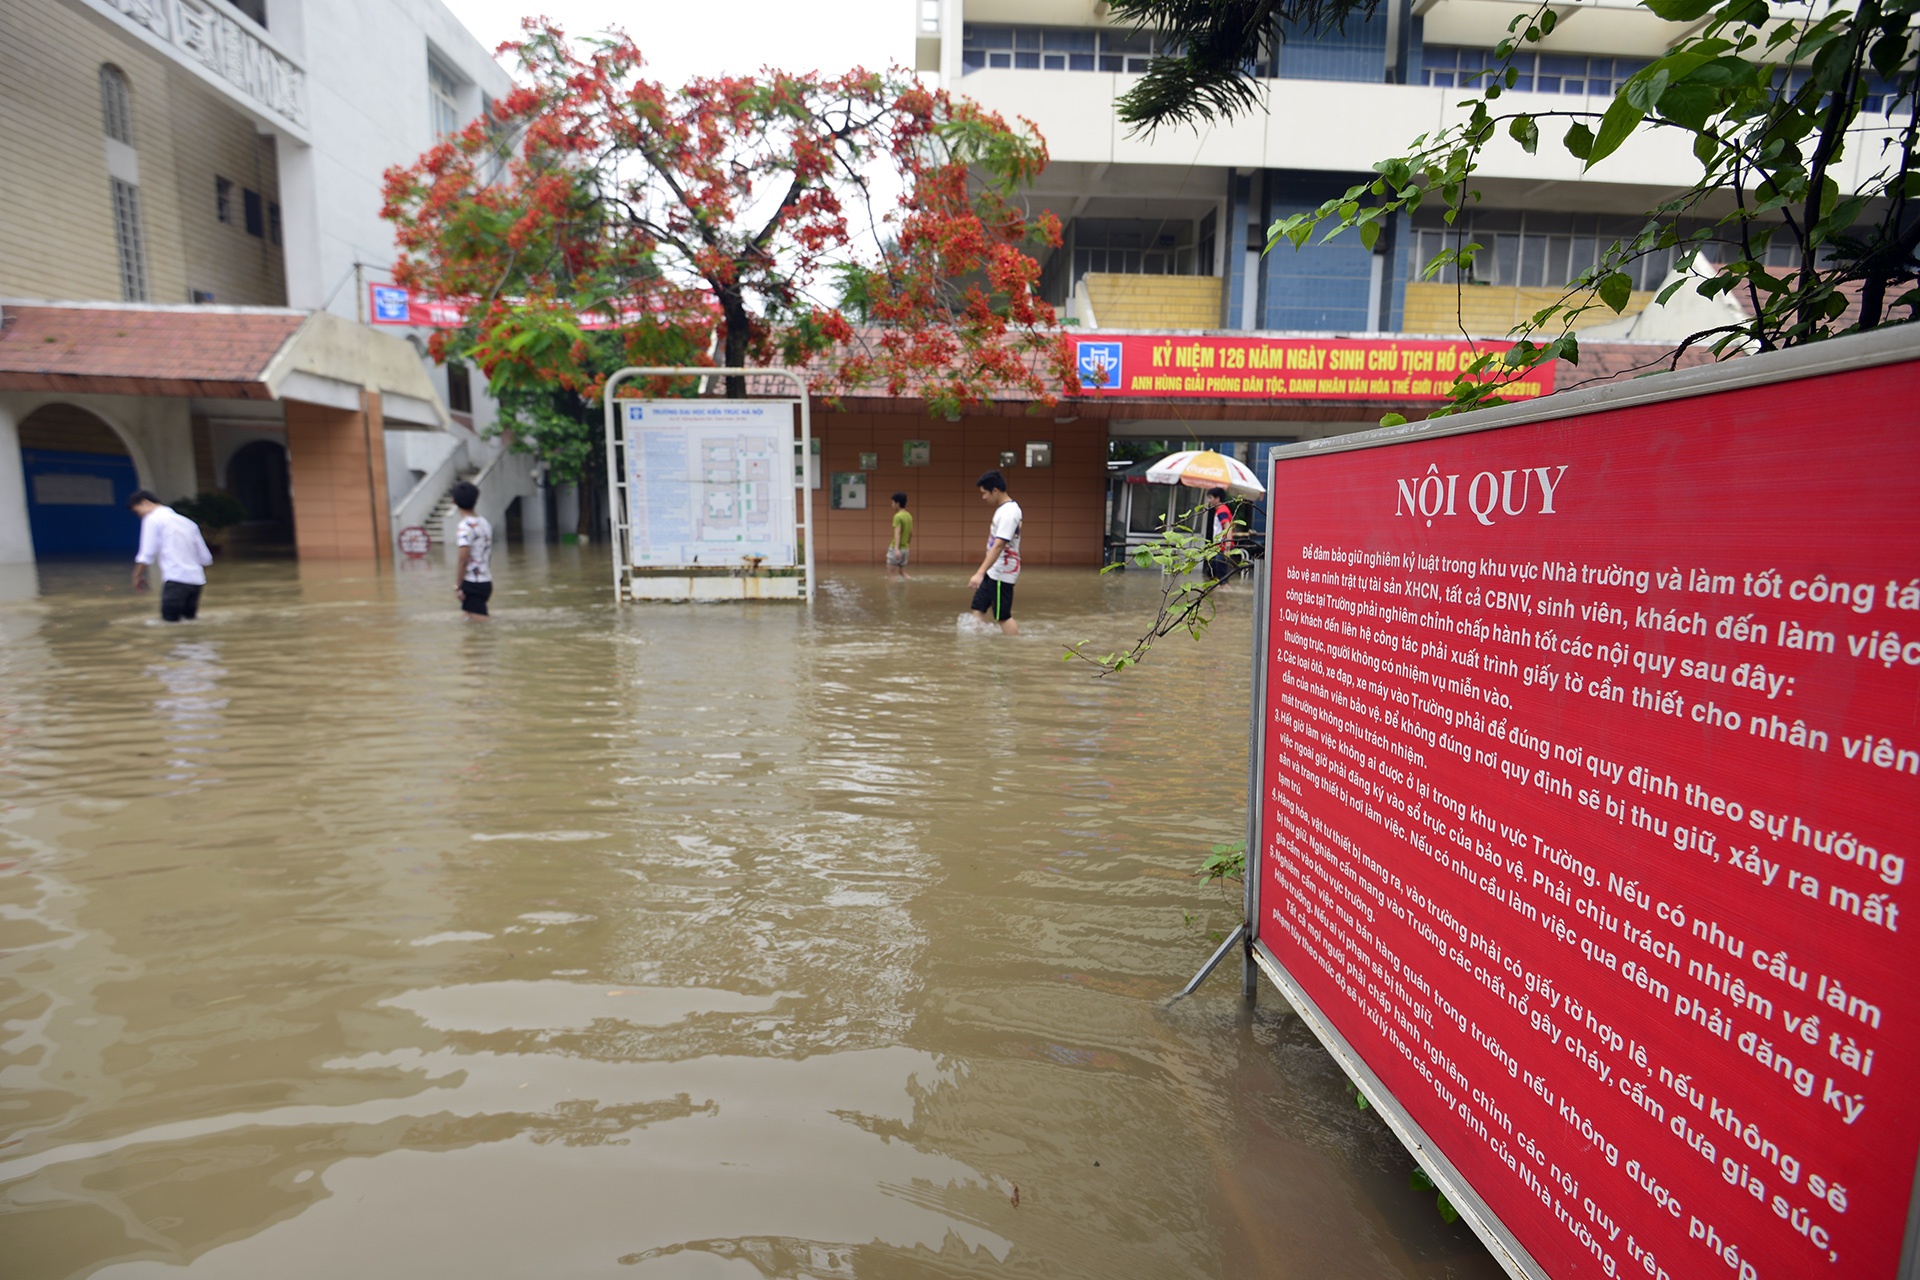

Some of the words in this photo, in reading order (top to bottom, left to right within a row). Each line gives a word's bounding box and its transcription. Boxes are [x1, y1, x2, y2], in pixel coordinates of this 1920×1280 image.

[1131, 376, 1152, 390] ANH
[1154, 374, 1182, 391] HÙNG
[1184, 373, 1205, 391] GIẢI
[1207, 375, 1241, 392] PHÓNG
[1289, 378, 1316, 394] DANH
[1318, 376, 1346, 394] NHÂN
[1152, 339, 1172, 367] KỶ
[1176, 342, 1214, 372] NIỆM
[1219, 347, 1245, 369] 126
[1248, 343, 1283, 369] NĂM
[1286, 345, 1327, 370] NGÀY
[1329, 348, 1364, 371] SINH
[1368, 344, 1398, 371] CHỦ
[1401, 350, 1434, 375] TỊCH
[1394, 463, 1460, 528] NỘI
[1468, 465, 1569, 526] QUY
[1287, 566, 1300, 580] bảo
[1301, 569, 1309, 583] vệ
[1311, 572, 1320, 582] an
[1322, 571, 1339, 585] ninh
[1342, 574, 1356, 590] trật
[1358, 576, 1368, 592] tự
[1370, 576, 1381, 591] tài
[1384, 577, 1401, 594] sản
[1405, 581, 1441, 603] XHCN,
[1446, 584, 1462, 603] tất
[1466, 587, 1481, 606] cả
[1485, 590, 1531, 616] CBNV,
[1537, 597, 1574, 618] sinh
[1581, 602, 1627, 629] viên,
[1636, 606, 1706, 636] khách
[1716, 614, 1767, 644] đến
[1778, 621, 1834, 653] làm
[1848, 631, 1920, 668] việc
[1303, 543, 1313, 559] Để
[1314, 546, 1330, 560] đảm
[1332, 547, 1347, 562] bảo
[1348, 550, 1363, 566] giữ
[1364, 551, 1400, 568] nghiêm
[1403, 551, 1415, 572] kỷ
[1418, 554, 1439, 573] luật
[1442, 557, 1476, 578] trong
[1480, 558, 1506, 576] khu
[1510, 562, 1538, 582] vực
[1542, 562, 1576, 582] Nhà
[1582, 564, 1649, 593] trường
[1656, 567, 1682, 590] và
[1689, 568, 1735, 594] làm
[1743, 568, 1782, 598] tốt
[1789, 574, 1874, 613] công
[1286, 588, 1303, 605] công
[1304, 591, 1315, 604] tác
[1316, 594, 1325, 608] tại
[1327, 595, 1356, 616] Trường
[1357, 600, 1377, 616] phải
[1379, 606, 1417, 624] nghiêm
[1420, 611, 1453, 632] chỉnh
[1457, 618, 1489, 642] chấp
[1493, 624, 1530, 647] hành
[1535, 629, 1557, 652] tốt
[1561, 636, 1593, 658] các
[1597, 642, 1629, 667] nội
[1633, 651, 1676, 678] quy
[1680, 659, 1726, 683] sau
[1732, 663, 1794, 699] đây:
[1523, 664, 1559, 691] giấy
[1565, 672, 1583, 692] tờ
[1588, 676, 1624, 703] cần
[1632, 687, 1684, 717] thiết
[1691, 702, 1741, 730] cho
[1750, 715, 1828, 752] nhân
[1842, 735, 1919, 774] viên
[1488, 718, 1507, 739] để
[1509, 727, 1550, 759] đúng
[1554, 745, 1582, 766] nơi
[1587, 756, 1624, 784] quy
[1628, 766, 1678, 800] định
[1685, 784, 1743, 821] theo
[1749, 810, 1788, 841] sự
[1792, 817, 1904, 885] hướng
[1501, 760, 1530, 785] quy
[1534, 770, 1572, 799] định
[1578, 789, 1600, 809] sẽ
[1606, 795, 1625, 825] bị
[1631, 806, 1667, 837] thu
[1674, 826, 1719, 862] giữ,
[1728, 845, 1779, 886] xảy
[1788, 870, 1818, 899] ra
[1830, 886, 1899, 931] mất
[1470, 805, 1496, 832] khu
[1501, 824, 1527, 847] vực
[1533, 835, 1600, 887] Trường.
[1608, 872, 1649, 910] Nếu
[1657, 902, 1685, 927] có
[1693, 919, 1744, 958] nhu
[1752, 950, 1807, 991] cầu
[1818, 975, 1880, 1029] làm
[1476, 839, 1502, 867] bảo
[1506, 859, 1527, 882] vệ.
[1533, 870, 1571, 906] Phải
[1576, 899, 1617, 932] chịu
[1624, 920, 1680, 968] trách
[1689, 959, 1772, 1020] nhiệm
[1784, 1011, 1819, 1044] về
[1830, 1033, 1873, 1076] tài
[1509, 890, 1536, 921] làm
[1542, 913, 1576, 944] việc
[1581, 938, 1616, 971] qua
[1622, 961, 1669, 1003] đêm
[1675, 994, 1732, 1041] phải
[1738, 1031, 1814, 1096] đăng
[1823, 1078, 1864, 1124] ký
[1504, 957, 1522, 978] có
[1525, 972, 1560, 1008] giấy
[1565, 996, 1583, 1020] tờ
[1586, 1010, 1623, 1051] hợp
[1660, 1066, 1704, 1110] nếu
[1710, 1097, 1799, 1184] không
[1808, 1174, 1847, 1212] sẽ
[1508, 992, 1529, 1015] nổ
[1531, 1010, 1561, 1044] gây
[1565, 1036, 1613, 1086] cháy,
[1619, 1078, 1664, 1122] cấm
[1671, 1116, 1715, 1163] đưa
[1722, 1158, 1764, 1201] gia
[1772, 1196, 1837, 1262] súc,
[1491, 1138, 1516, 1171] của
[1519, 1162, 1551, 1208] Nhà
[1518, 1132, 1545, 1165] các
[1551, 1164, 1578, 1199] nội
[1584, 1198, 1620, 1241] quy
[1524, 1070, 1553, 1106] nếu
[1560, 1097, 1618, 1166] không
[1626, 1160, 1681, 1217] được
